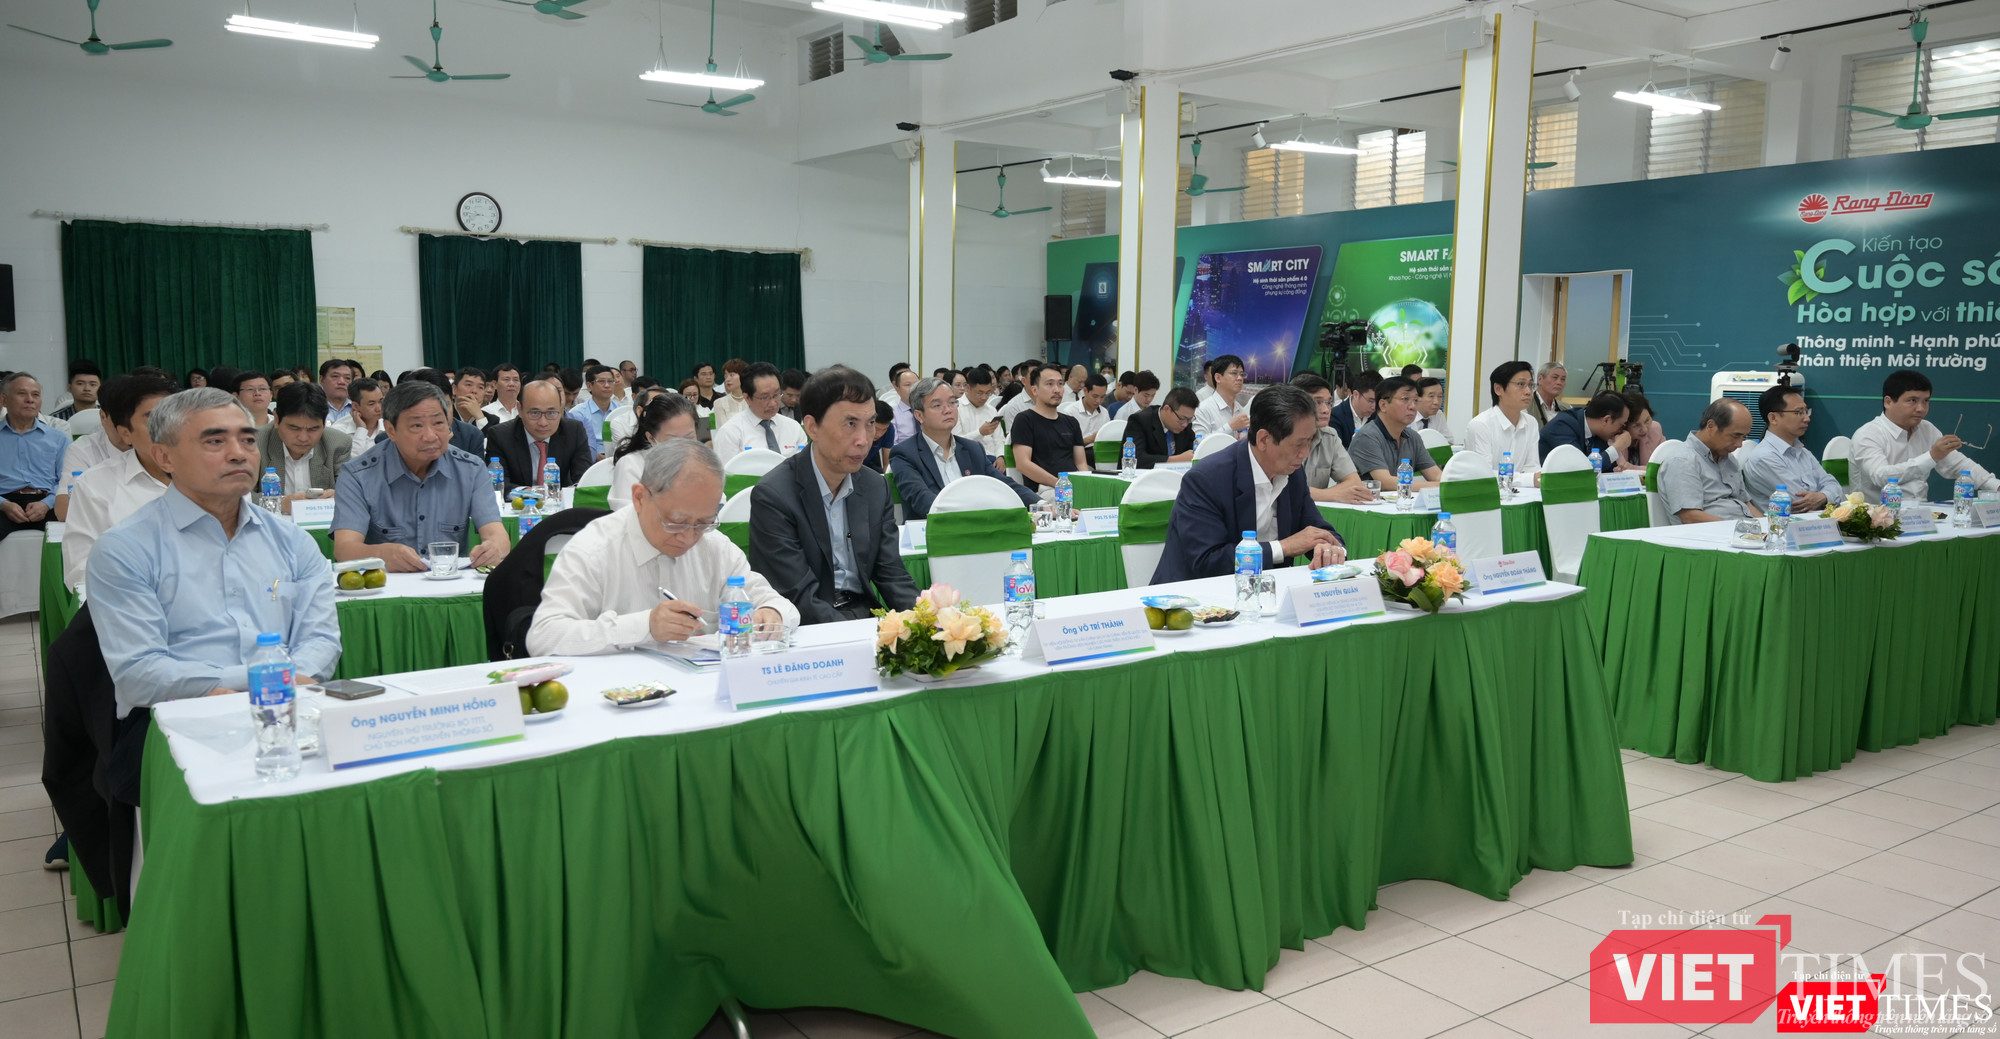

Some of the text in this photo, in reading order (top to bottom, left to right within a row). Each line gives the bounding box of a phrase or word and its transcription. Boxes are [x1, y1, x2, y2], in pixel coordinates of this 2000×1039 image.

[1862, 235, 1943, 253] Kiến tạo
[1400, 249, 1439, 262] SMART
[1248, 258, 1309, 273] SMART CITY
[1801, 238, 1946, 298] Cuộc
[1797, 301, 2000, 327] Hòa hợp với thi
[1796, 335, 1847, 352] Thông
[1852, 335, 1895, 348] minh
[1910, 334, 1959, 352] Hạnh
[1839, 354, 1882, 370] thiện
[1887, 354, 1920, 367] Môi
[1925, 353, 1987, 371] trường
[1062, 626, 1077, 635] Ông
[1090, 622, 1100, 630] TRÍ
[1101, 620, 1124, 628] THÀNH
[762, 659, 844, 675] TS LÊ ĐĂNG DOANH
[351, 697, 497, 728] Ông NGUYỄN MINH HỒNG
